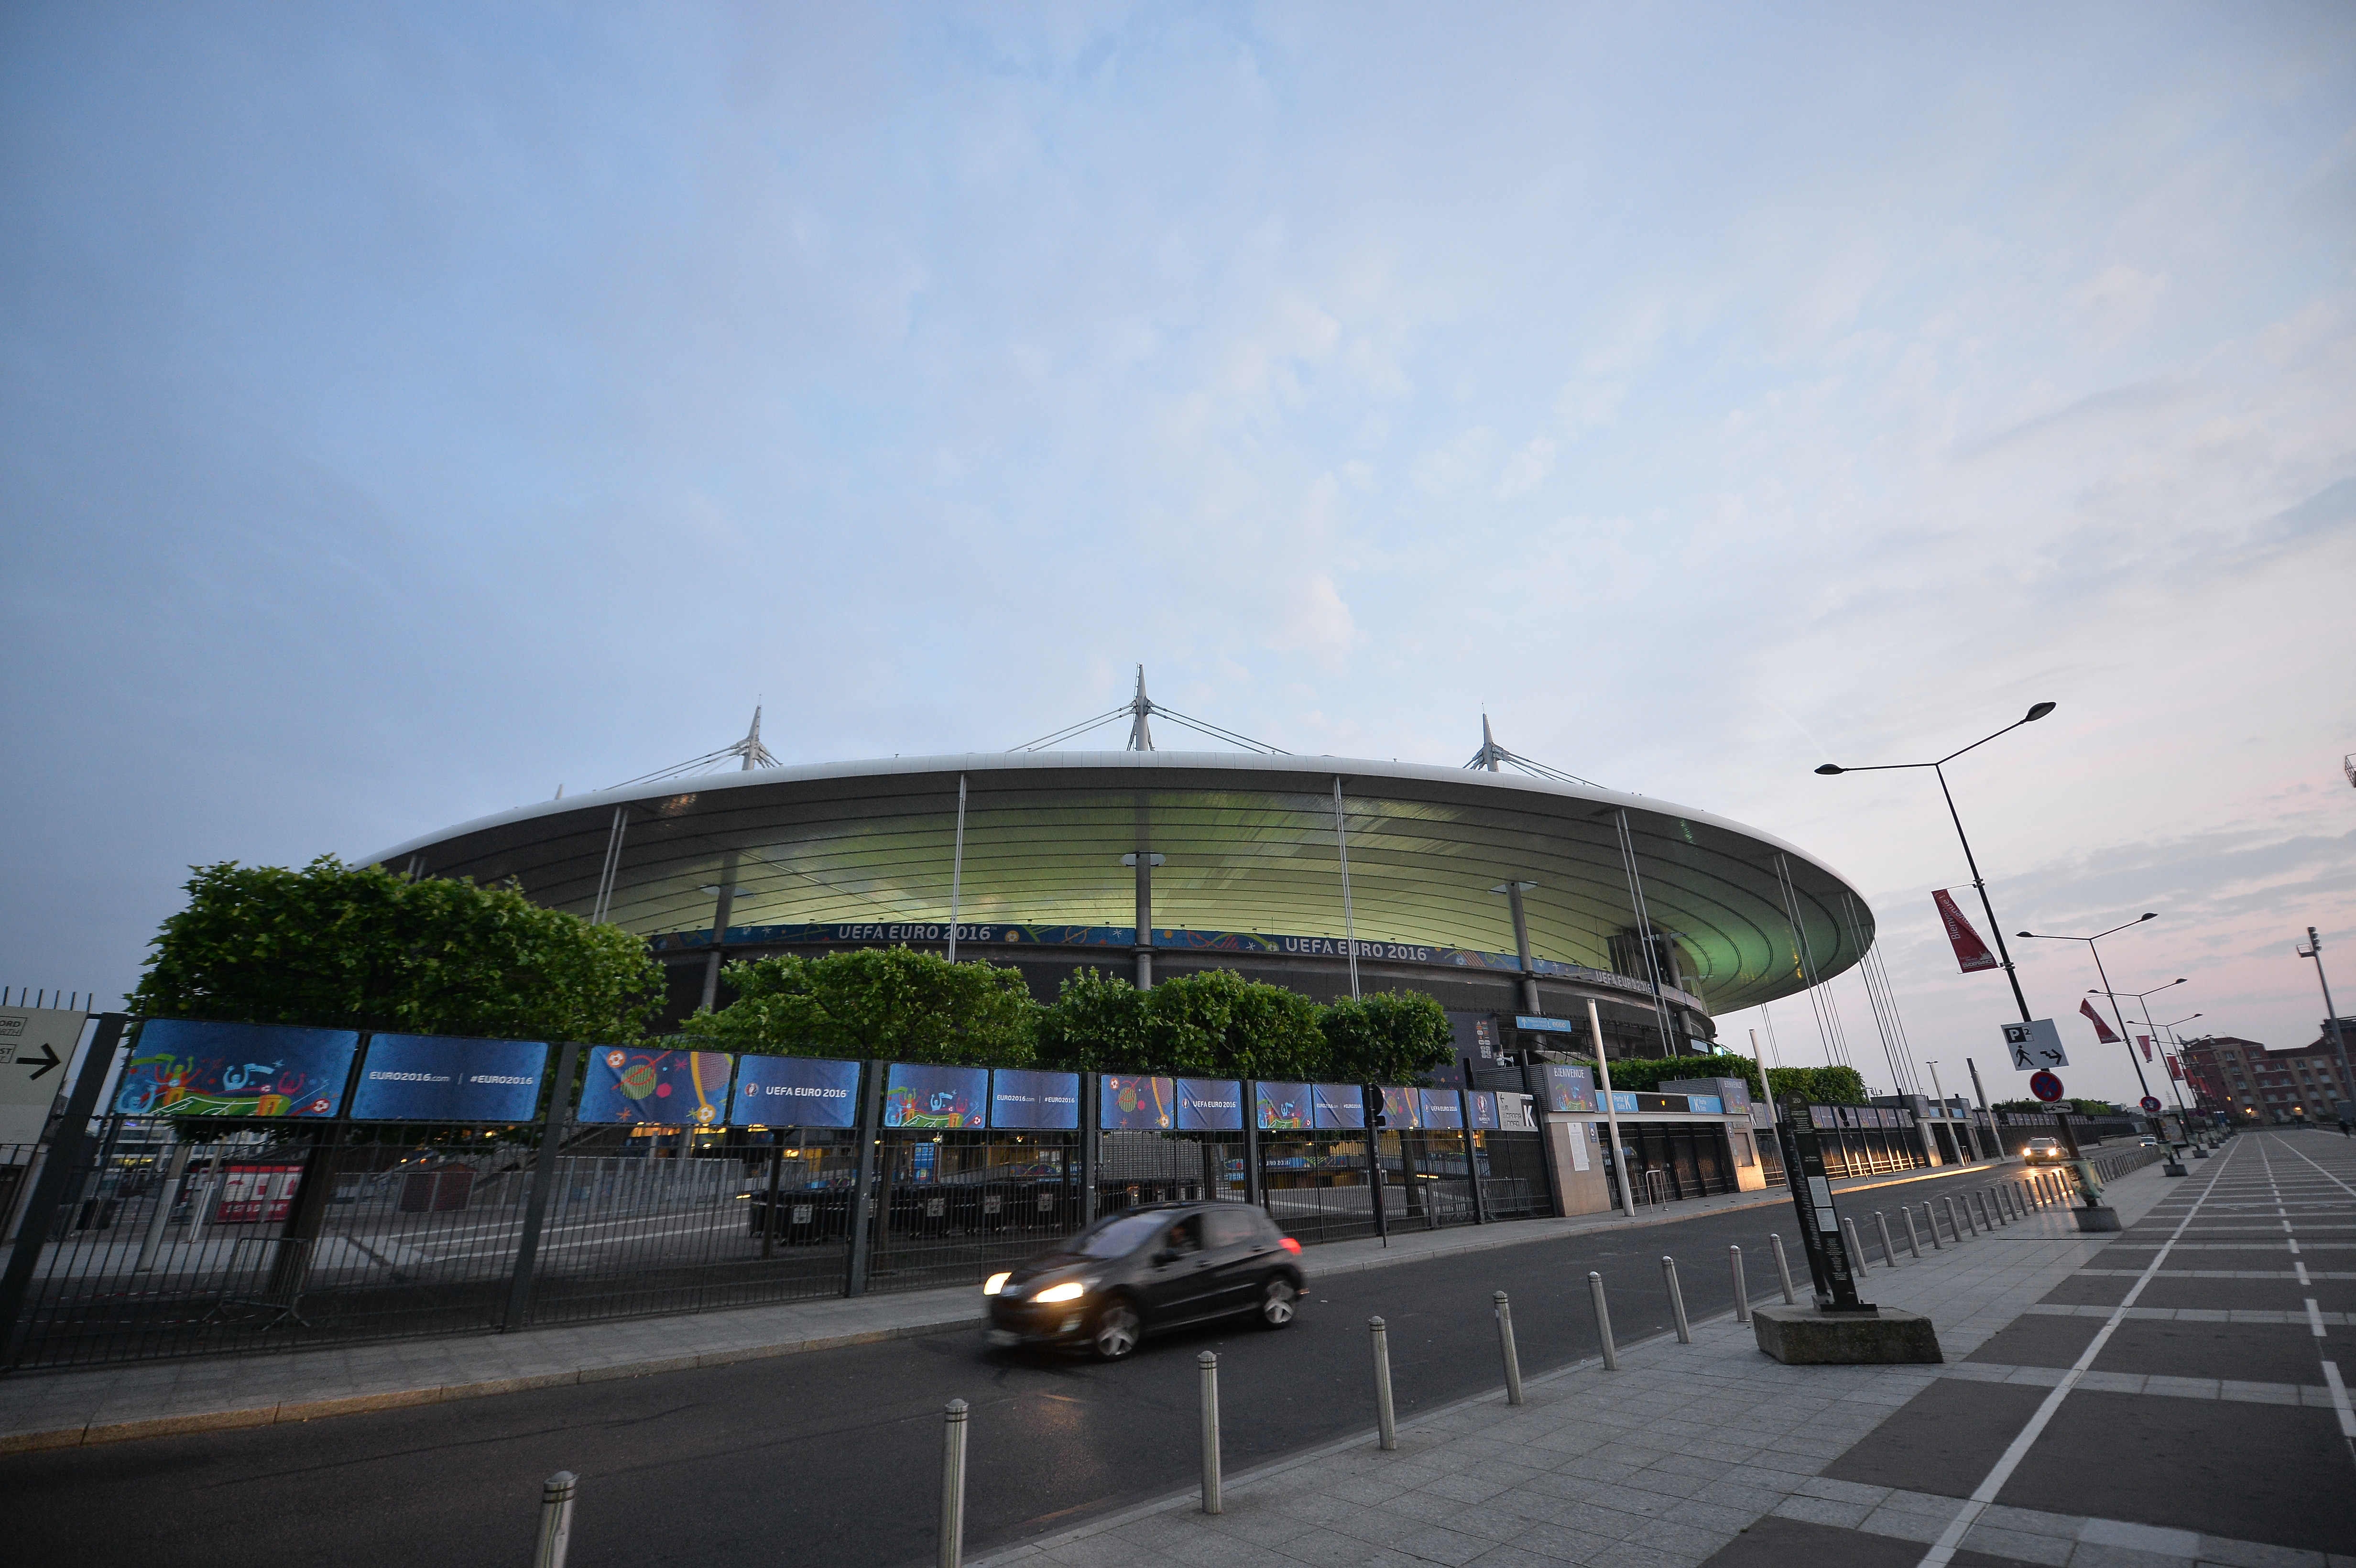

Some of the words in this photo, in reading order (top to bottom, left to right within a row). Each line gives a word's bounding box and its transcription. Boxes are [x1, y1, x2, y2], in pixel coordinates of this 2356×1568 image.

[839, 926, 884, 939] UEFA
[888, 926, 938, 939] EURO
[1286, 937, 1333, 954] UEFA
[1337, 941, 1383, 957] EURO
[1596, 971, 1617, 986] UEFA
[2008, 1029, 2019, 1040] P
[369, 1071, 450, 1082] EURO2016.com
[470, 1075, 534, 1085] #EURO2016
[1554, 1067, 1585, 1079] BIENVENUE
[765, 1086, 793, 1096] UEFA
[794, 1087, 822, 1097] EURO
[1523, 1105, 1535, 1127] K
